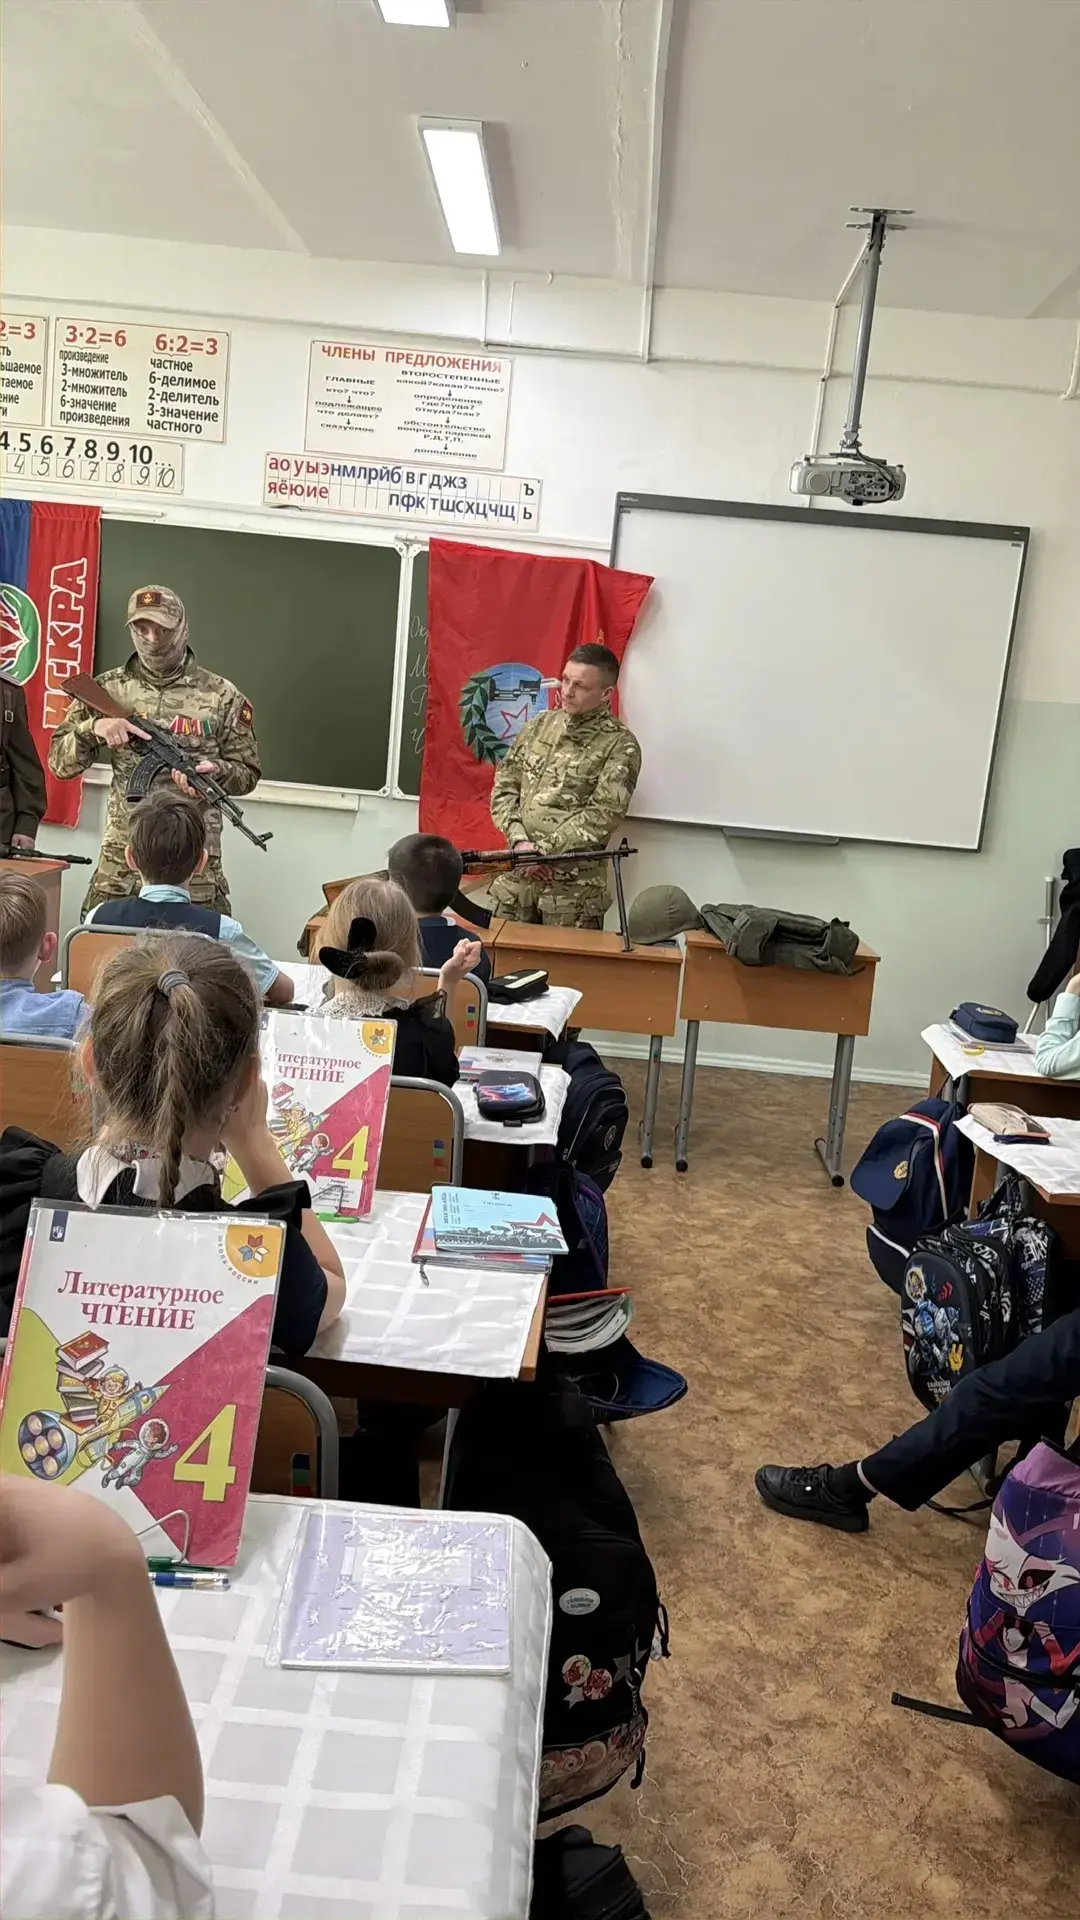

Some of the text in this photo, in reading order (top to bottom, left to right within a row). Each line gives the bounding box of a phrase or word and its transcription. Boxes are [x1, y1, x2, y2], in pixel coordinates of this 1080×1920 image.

[155, 333, 218, 356] 6:2=3
[59, 349, 109, 364] произведение
[150, 357, 193, 372] частное
[321, 345, 502, 373] ЧЛЕНЫ ПРЕДЛОЖЕНИЯ
[61, 363, 128, 382] 3-множитель
[149, 372, 216, 390] 6-делимое
[325, 375, 376, 385] ГЛАВНЫЕ
[401, 370, 501, 384] ВТОРОСТЕПЕННЫЕ
[61, 379, 128, 398] 2-множитель
[148, 387, 220, 406] 2-делитель
[60, 395, 117, 413] 6-значение
[315, 401, 382, 412] подлежащее
[414, 394, 483, 404] определение
[59, 410, 130, 427] произведения
[147, 403, 219, 422] 3-значение
[337, 411, 379, 419] делает?
[147, 419, 203, 435] частного
[320, 423, 374, 433] сказуемое
[397, 426, 442, 434] вопросы
[404, 420, 486, 432] обстоятельство
[414, 448, 477, 458] дополнение
[43, 558, 87, 729] ИСКРА
[275, 1048, 362, 1069] итературное
[278, 1065, 345, 1083] ЧТЕНИЕ
[332, 1126, 369, 1179] 4
[57, 1271, 224, 1306] Литературное
[80, 1302, 196, 1330] ЧТЕНИЕ
[173, 1404, 237, 1502] 4
